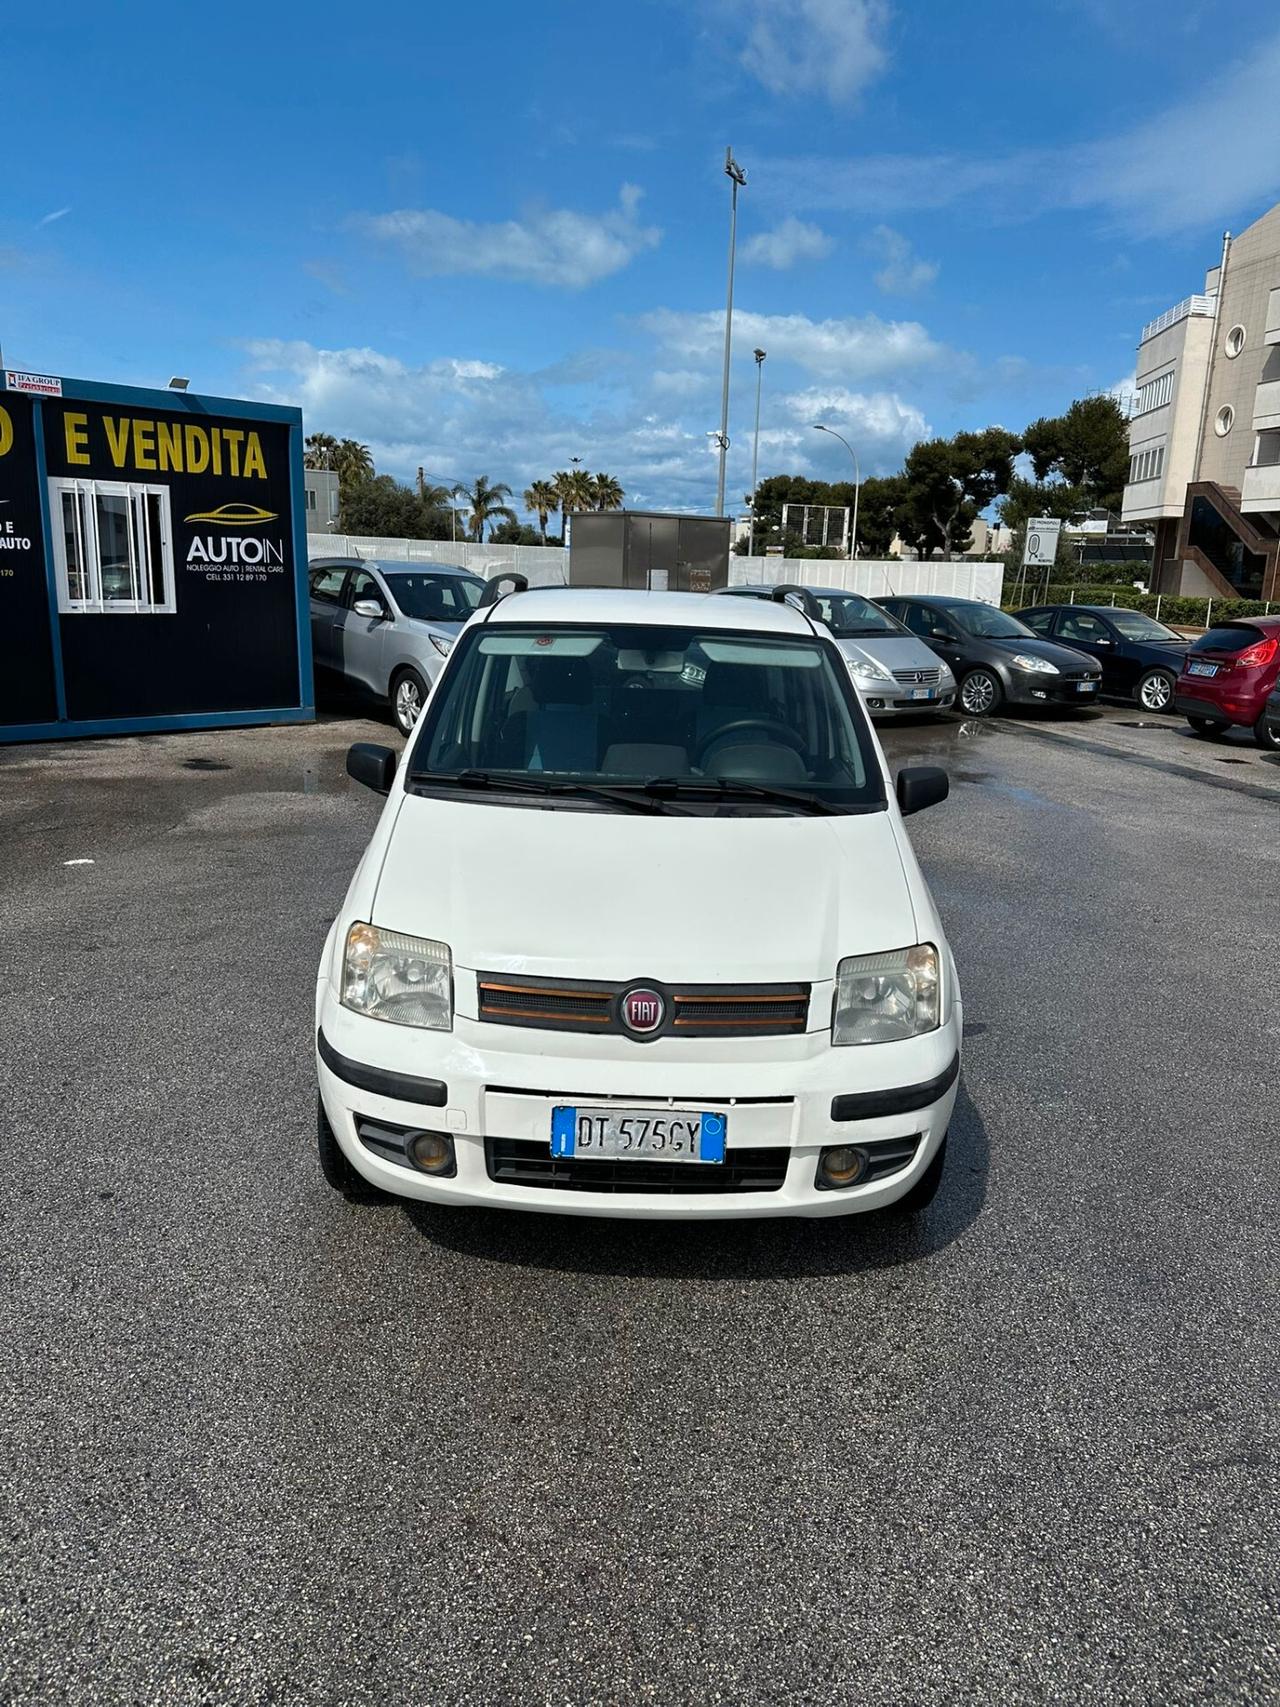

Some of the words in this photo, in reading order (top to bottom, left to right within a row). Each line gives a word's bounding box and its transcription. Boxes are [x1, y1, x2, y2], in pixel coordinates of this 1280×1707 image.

[32, 376, 60, 386] GROUP
[63, 411, 91, 465] E
[102, 416, 268, 479] VENDITA
[0, 537, 31, 550] AUTO
[186, 536, 284, 563] AUTOIN
[186, 564, 222, 572] NOLEGGIO
[245, 565, 267, 573] RENTAL
[205, 573, 221, 581] CELL
[222, 573, 234, 581] 331
[255, 574, 268, 582] 170
[631, 1001, 657, 1021] FIAT
[578, 1116, 609, 1148] DT
[619, 1119, 700, 1153] 575GY
